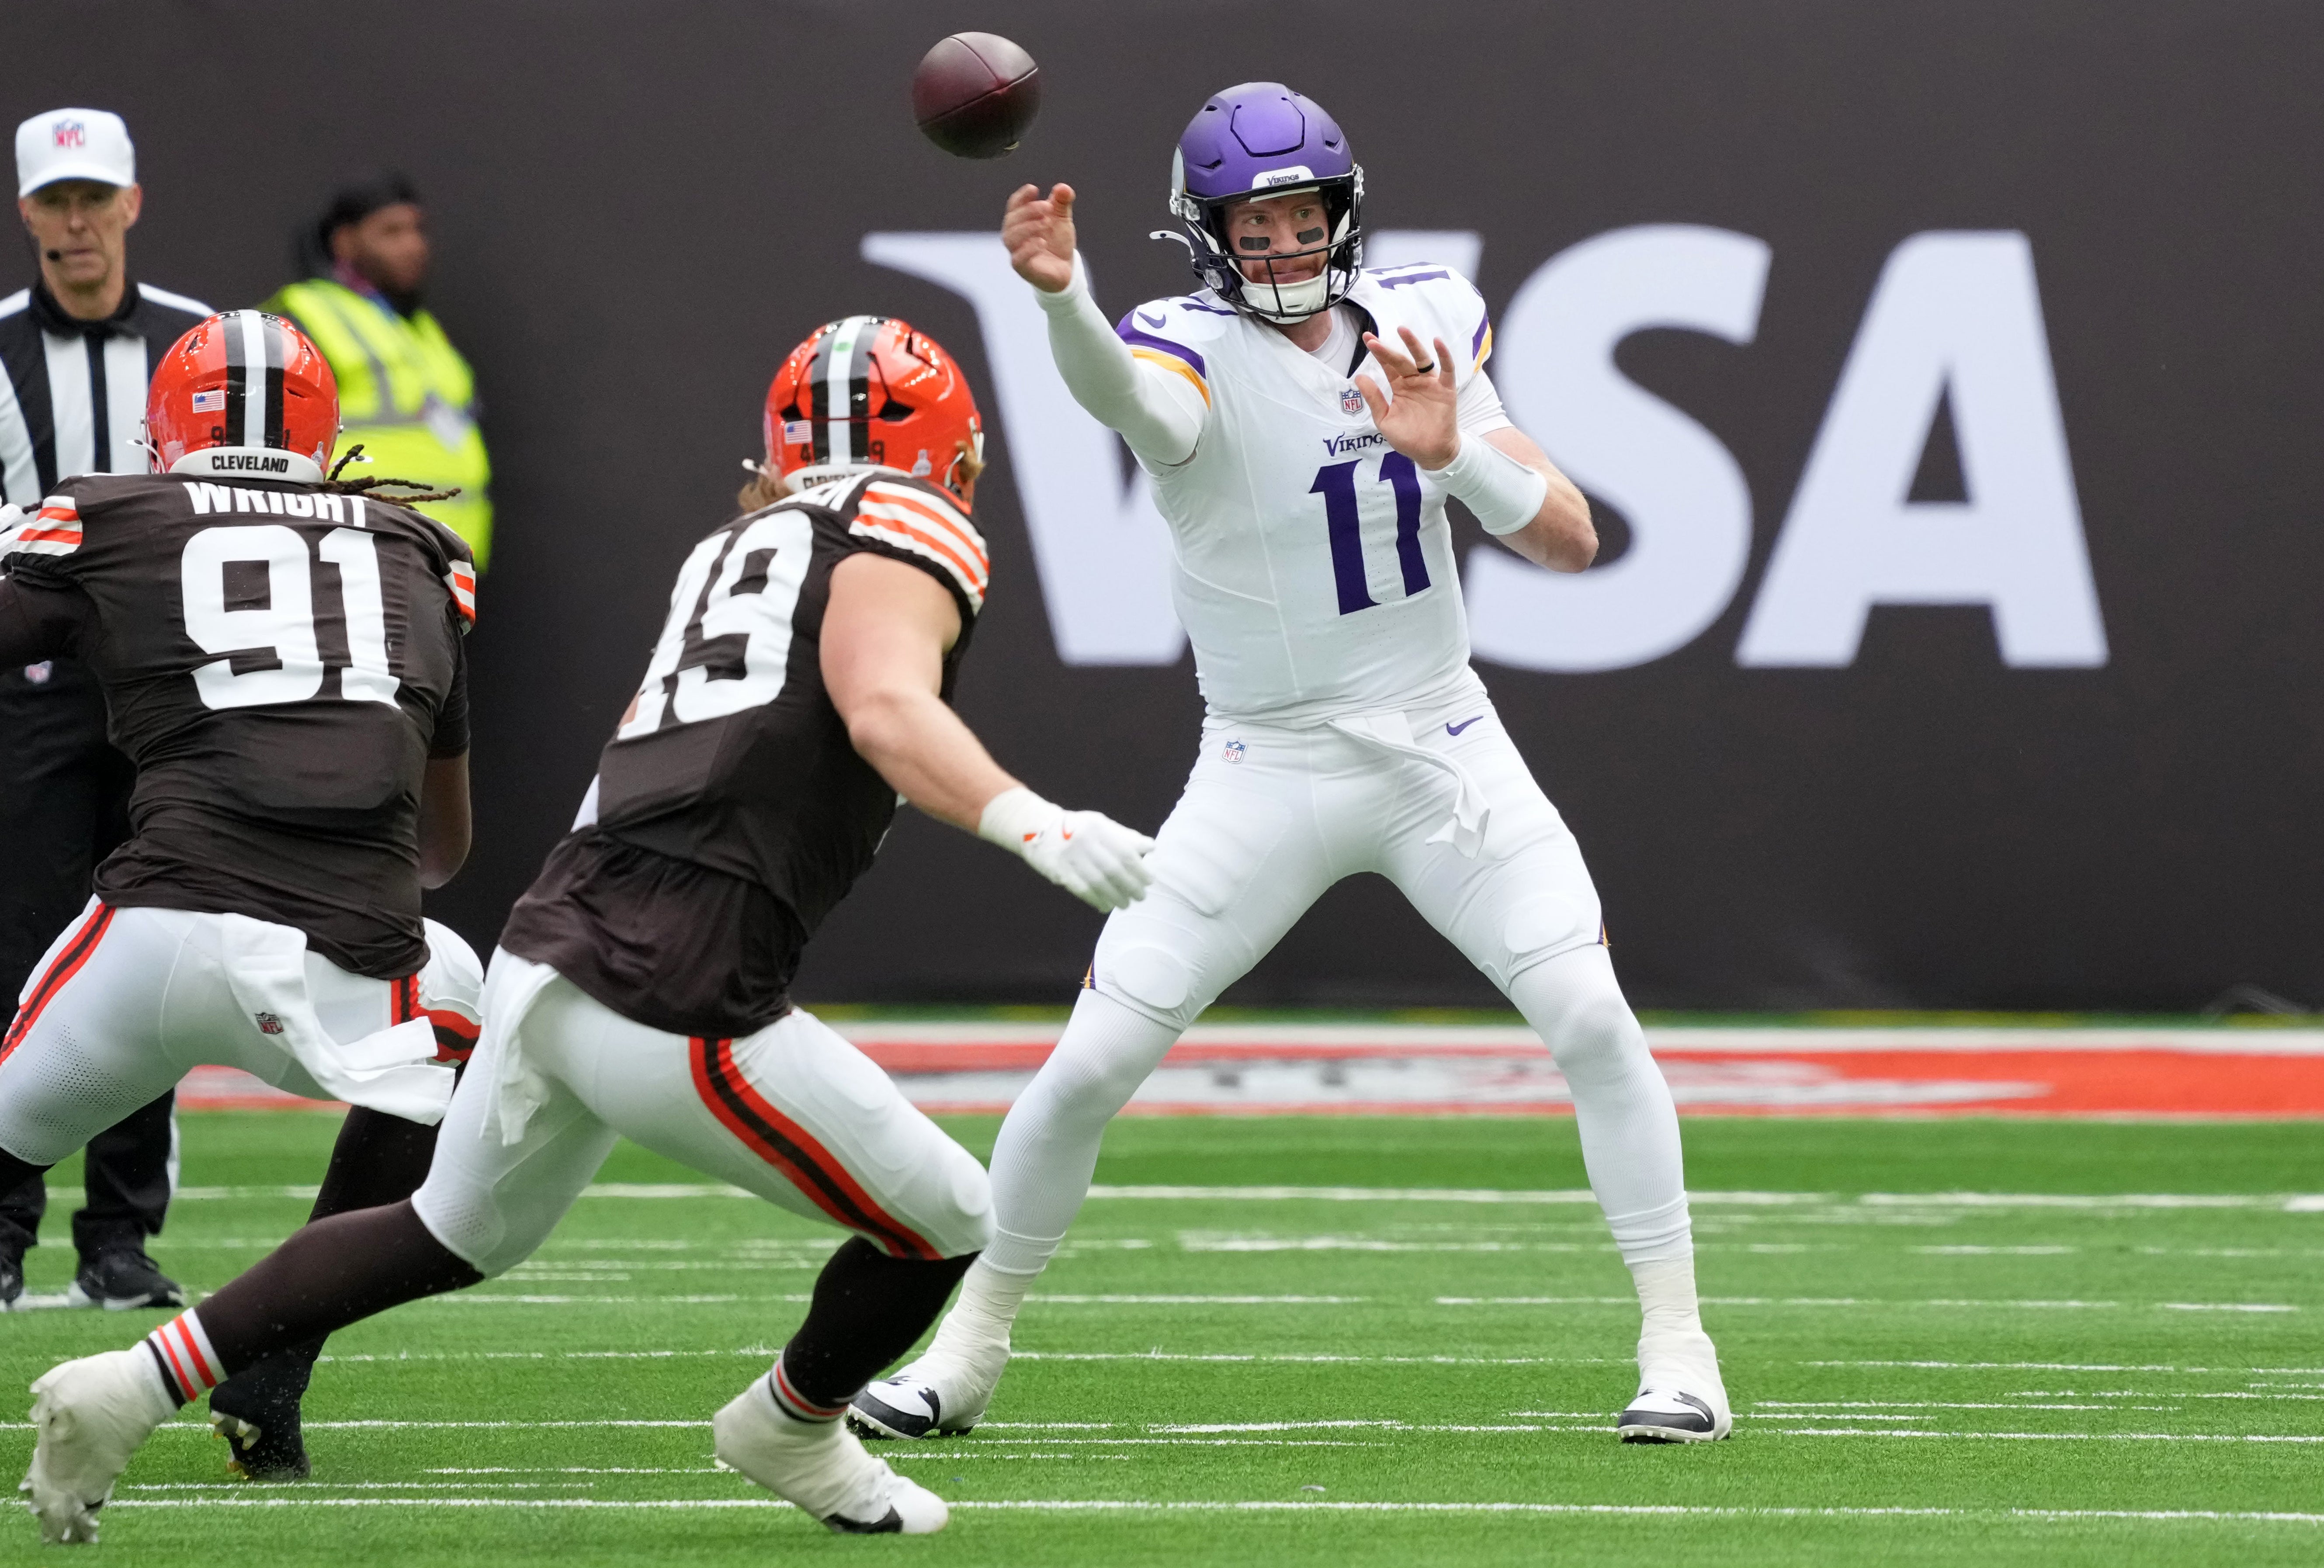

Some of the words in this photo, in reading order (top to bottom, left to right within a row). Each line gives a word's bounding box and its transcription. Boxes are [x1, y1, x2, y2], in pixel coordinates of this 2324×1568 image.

[1344, 399, 1361, 411] NFL
[862, 222, 2109, 671] VSA
[1323, 431, 1388, 457] VIKING
[212, 455, 289, 473] CLEVELAND
[183, 482, 369, 528] WRIGHT
[1308, 450, 1431, 616] 11
[181, 524, 402, 710] 91
[1224, 748, 1240, 761] NFL
